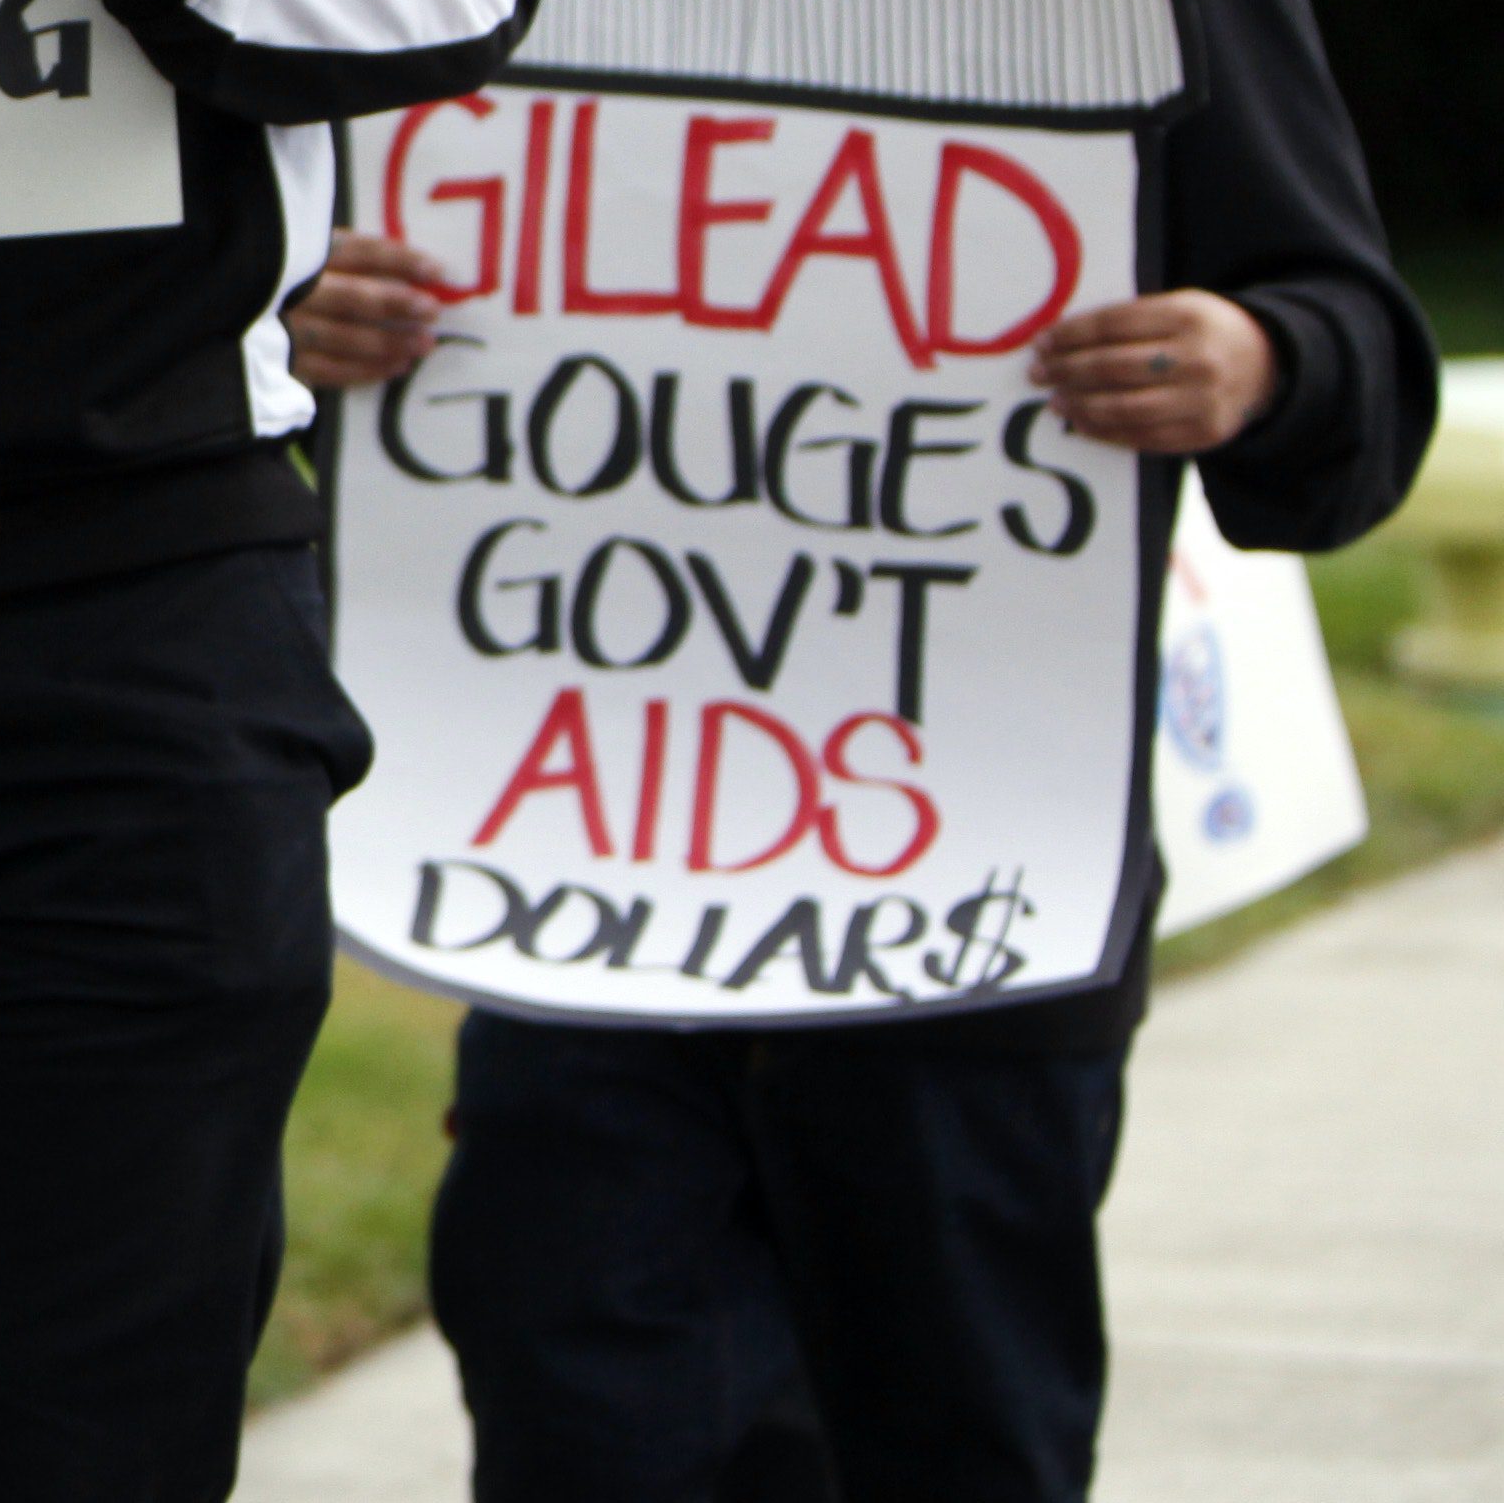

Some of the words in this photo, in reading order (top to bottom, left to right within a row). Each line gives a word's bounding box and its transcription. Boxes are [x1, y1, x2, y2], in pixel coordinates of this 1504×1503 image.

[381, 93, 1084, 370] GILEAD
[378, 334, 1097, 558] GOUGES
[456, 518, 979, 725] GOV'T
[471, 687, 941, 878] AIDS
[409, 859, 1036, 1002] DOLLAR$
